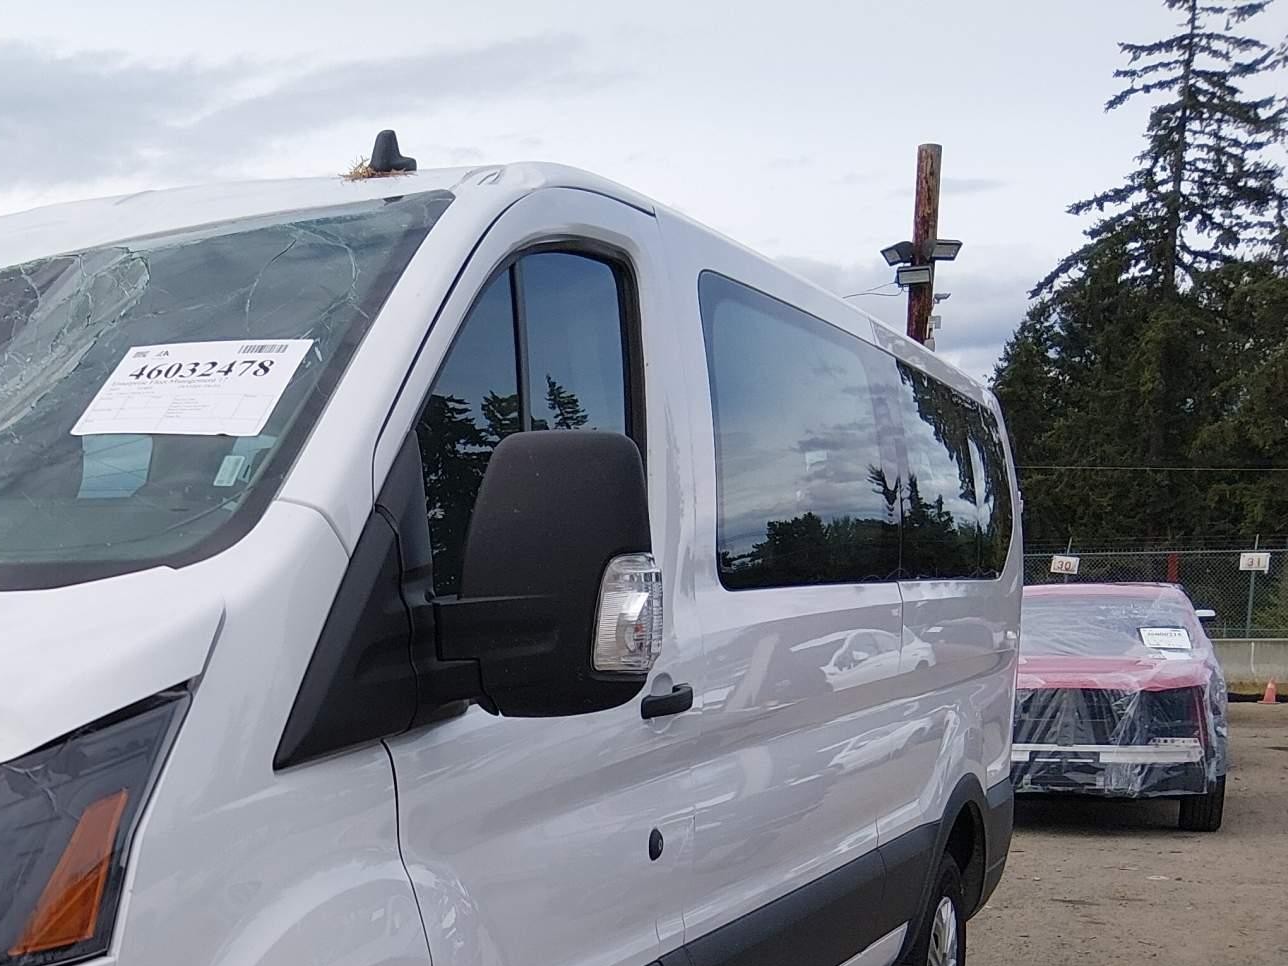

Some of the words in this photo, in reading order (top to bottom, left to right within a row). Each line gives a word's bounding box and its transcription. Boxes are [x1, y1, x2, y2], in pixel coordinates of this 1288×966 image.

[129, 359, 275, 380] 46032478
[1057, 560, 1072, 571] 30
[1247, 557, 1261, 567] 31
